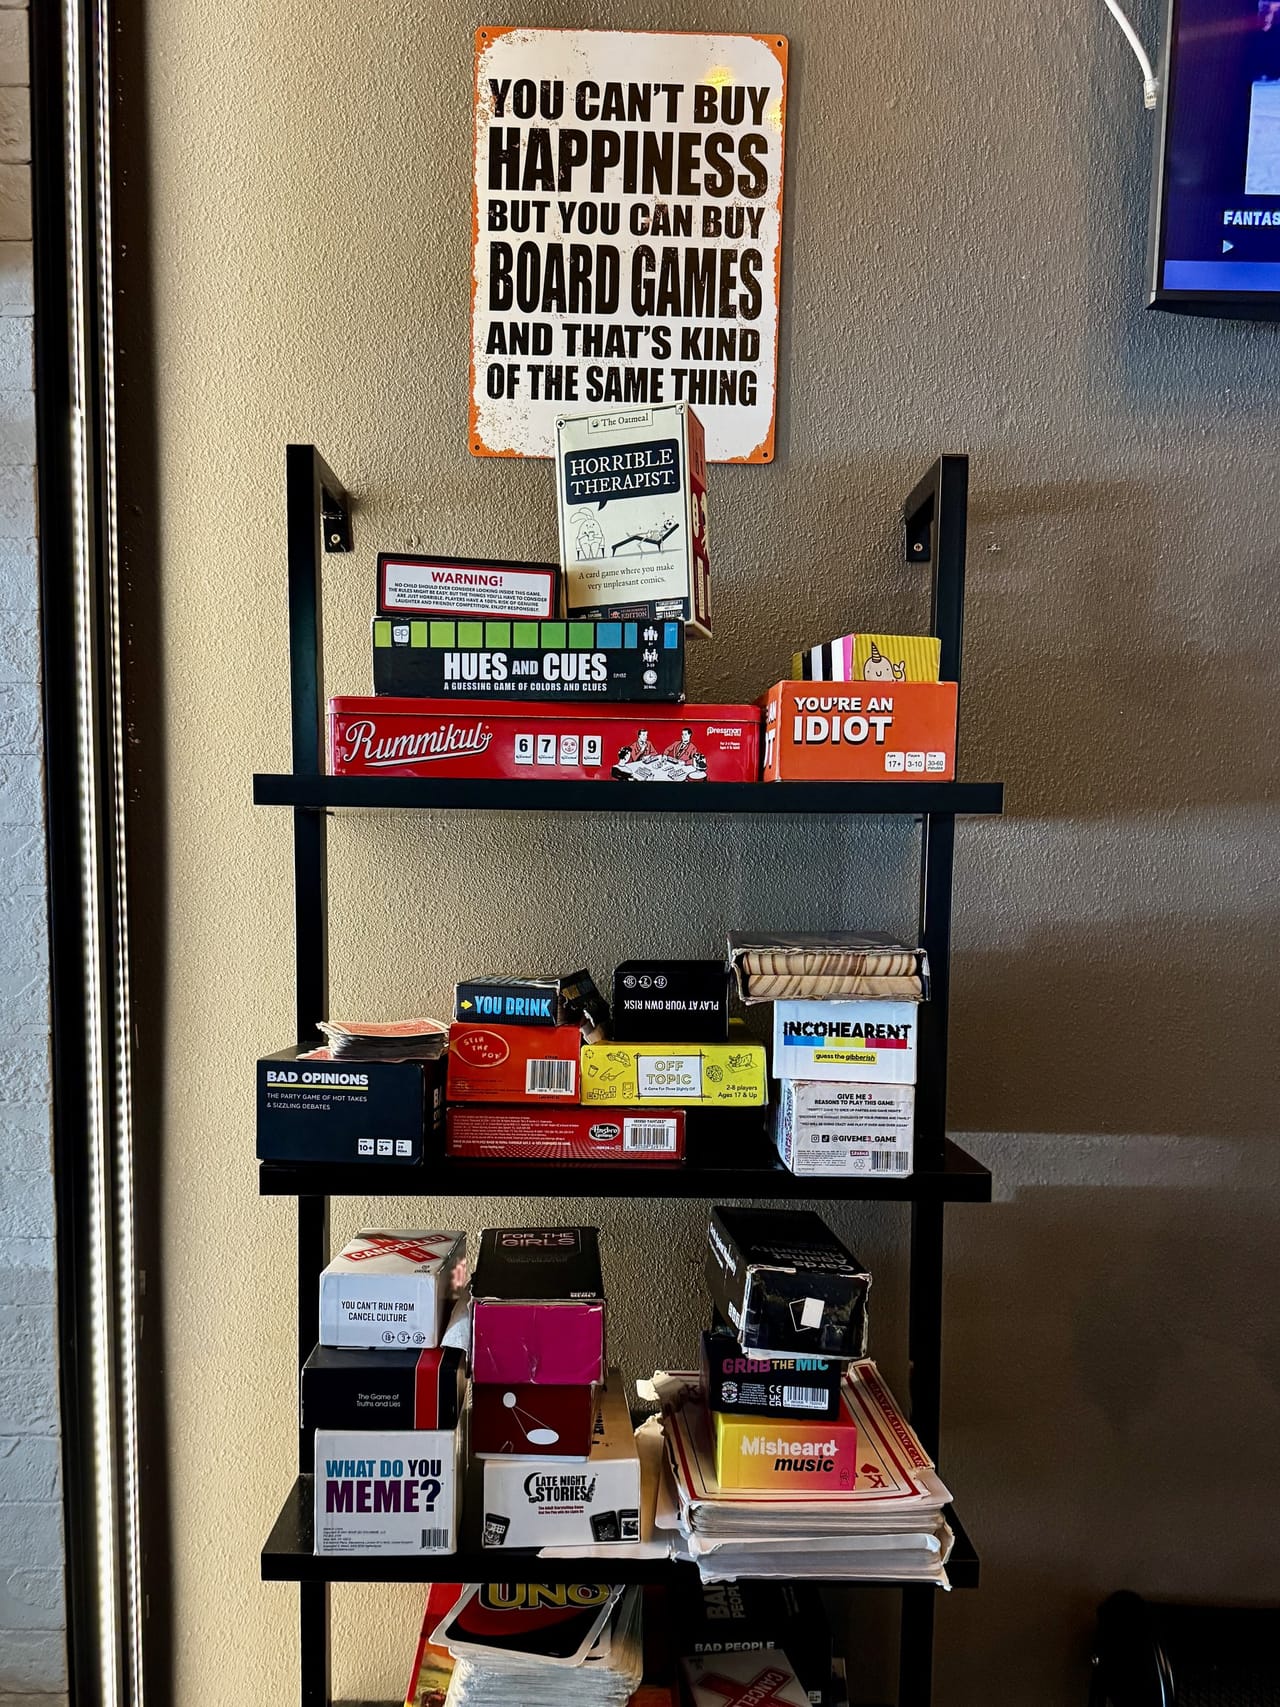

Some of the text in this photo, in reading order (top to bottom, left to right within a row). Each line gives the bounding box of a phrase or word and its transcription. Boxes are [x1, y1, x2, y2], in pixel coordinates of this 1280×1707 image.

[489, 79, 770, 125] YOU CAN'T BUY
[488, 127, 768, 198] HAPPINESS
[488, 200, 765, 239] BUT YOU CAN BUY
[489, 241, 762, 320] BOARD GAMES
[486, 321, 760, 362] AND THAT'S KIND
[487, 363, 757, 406] OF THE SAME THING
[601, 413, 648, 426] The Oatmeal
[570, 448, 674, 477] HORRIBLE
[570, 469, 674, 496] THERAPIST
[641, 566, 654, 574] you
[656, 563, 674, 571] make
[431, 572, 503, 586] WARNING!
[588, 582, 602, 590] very
[603, 580, 639, 589] unpleasant
[443, 652, 607, 681] HUES AND CUES
[452, 682, 491, 691] GUESSING
[494, 683, 516, 691] GAME
[518, 683, 528, 691] OF
[530, 683, 561, 691] COLORS
[564, 683, 580, 691] AND
[582, 683, 607, 691] CLUES
[793, 697, 894, 712] YOU'RE AN
[793, 715, 893, 743] IDIOT
[343, 720, 492, 762] Rummikub
[519, 739, 596, 753] 6 7 9
[475, 996, 551, 1017] YOU DRINK
[624, 1000, 719, 1010] PLAY AT YOUR OWN RISK
[783, 1021, 912, 1039] INCOHEARENT
[655, 1061, 684, 1071] OFF
[266, 1070, 369, 1085] BAD OPINIONS
[646, 1074, 692, 1085] TOPIC
[351, 1235, 446, 1259] CANCELLED
[502, 1238, 575, 1247] GIRLS
[792, 1260, 854, 1271] Cards
[341, 1301, 415, 1311] YOU CAN'T RUN FROM
[349, 1312, 407, 1322] CANCEL CULTURE
[722, 1358, 829, 1373] GRAB THE MIC
[886, 1408, 912, 1446] PLAYING
[741, 1436, 840, 1456] Misheard
[325, 1459, 442, 1478] WHAT DO YOU
[774, 1455, 834, 1472] music
[536, 1475, 587, 1486] LATE NIGHT
[864, 1474, 888, 1488] K
[326, 1479, 441, 1513] MEME?
[536, 1486, 587, 1502] STORIES
[488, 1584, 611, 1608] UNO
[695, 1643, 722, 1652] BAD
